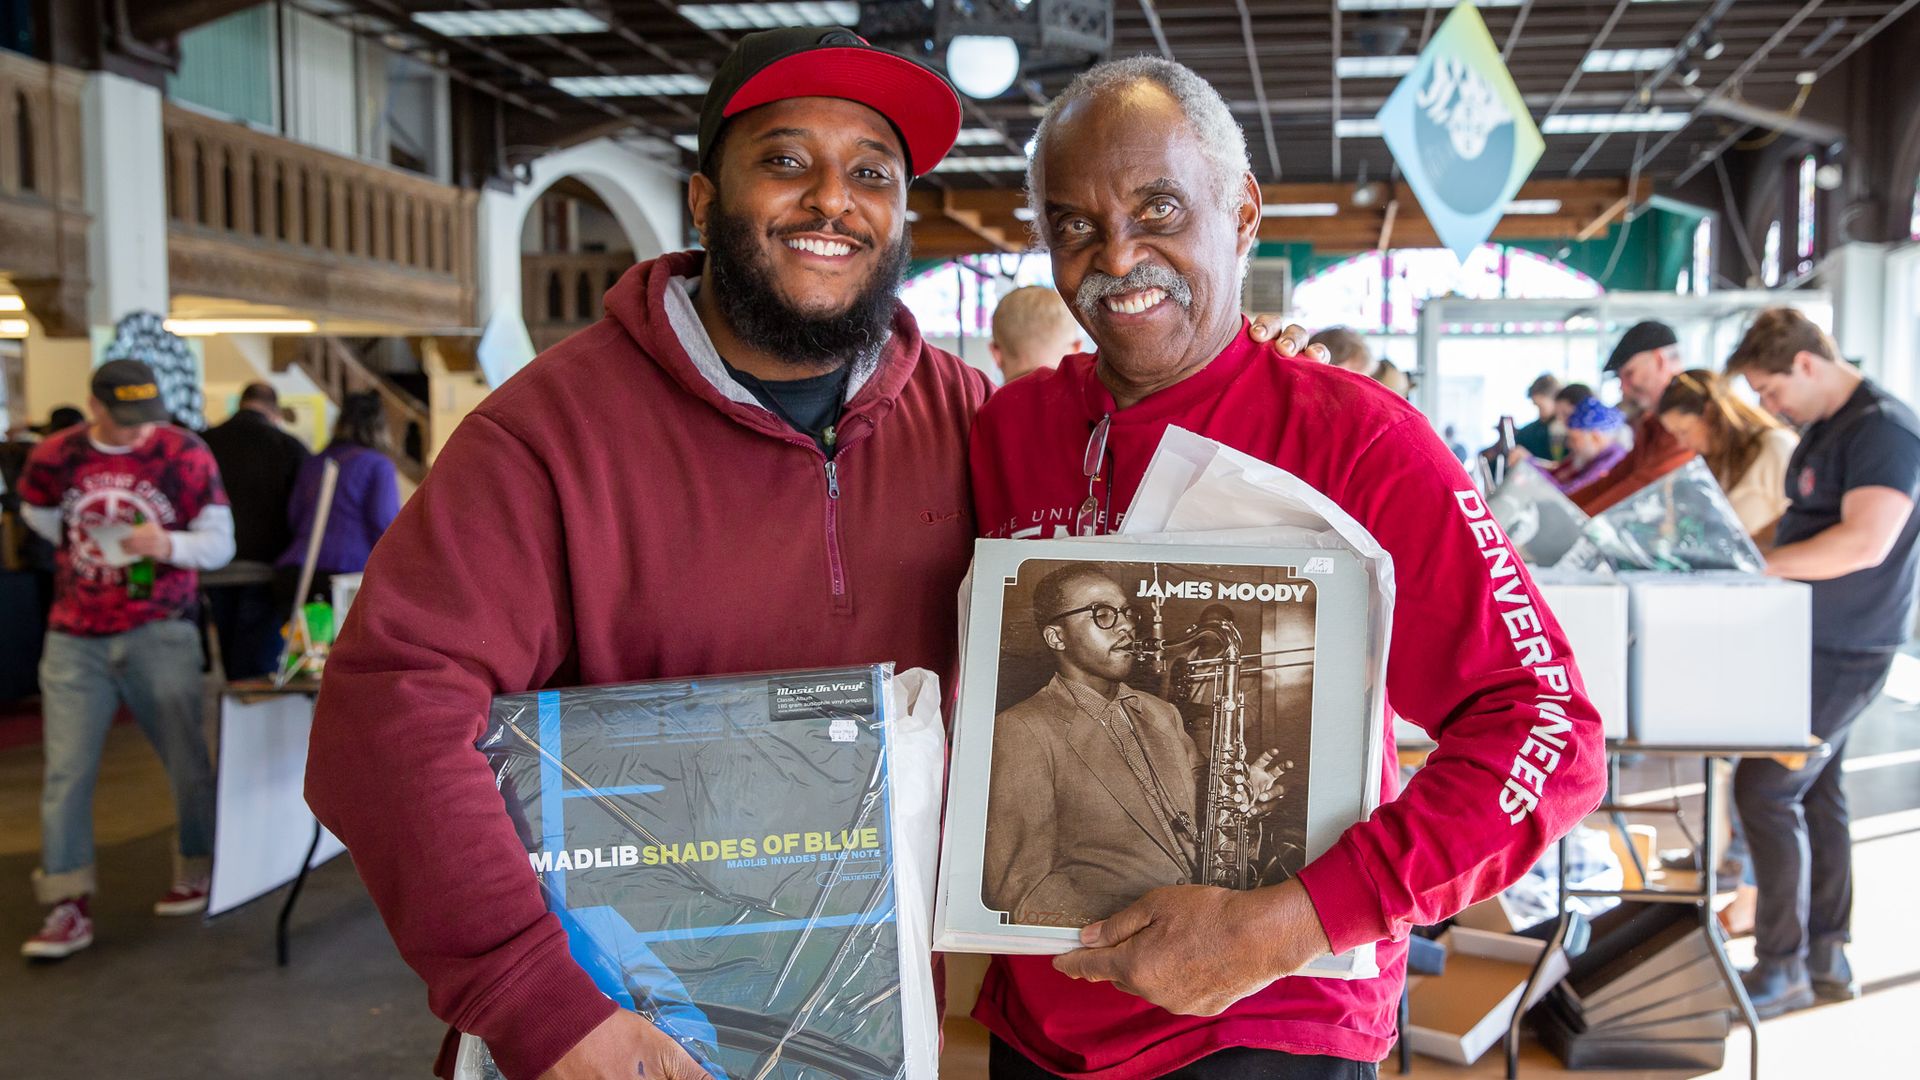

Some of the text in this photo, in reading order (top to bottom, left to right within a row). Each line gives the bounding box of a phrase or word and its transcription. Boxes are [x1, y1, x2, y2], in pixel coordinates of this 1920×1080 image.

[1454, 488, 1553, 666] DENVER
[1137, 580, 1309, 602] JAMES MOODY
[776, 682, 865, 696] Music On Vinyl
[845, 697, 868, 705] pressing
[528, 828, 879, 872] MADLIB SHADES OF BLUE
[727, 849, 881, 869] MADLIB INVADES BLUE NOTE
